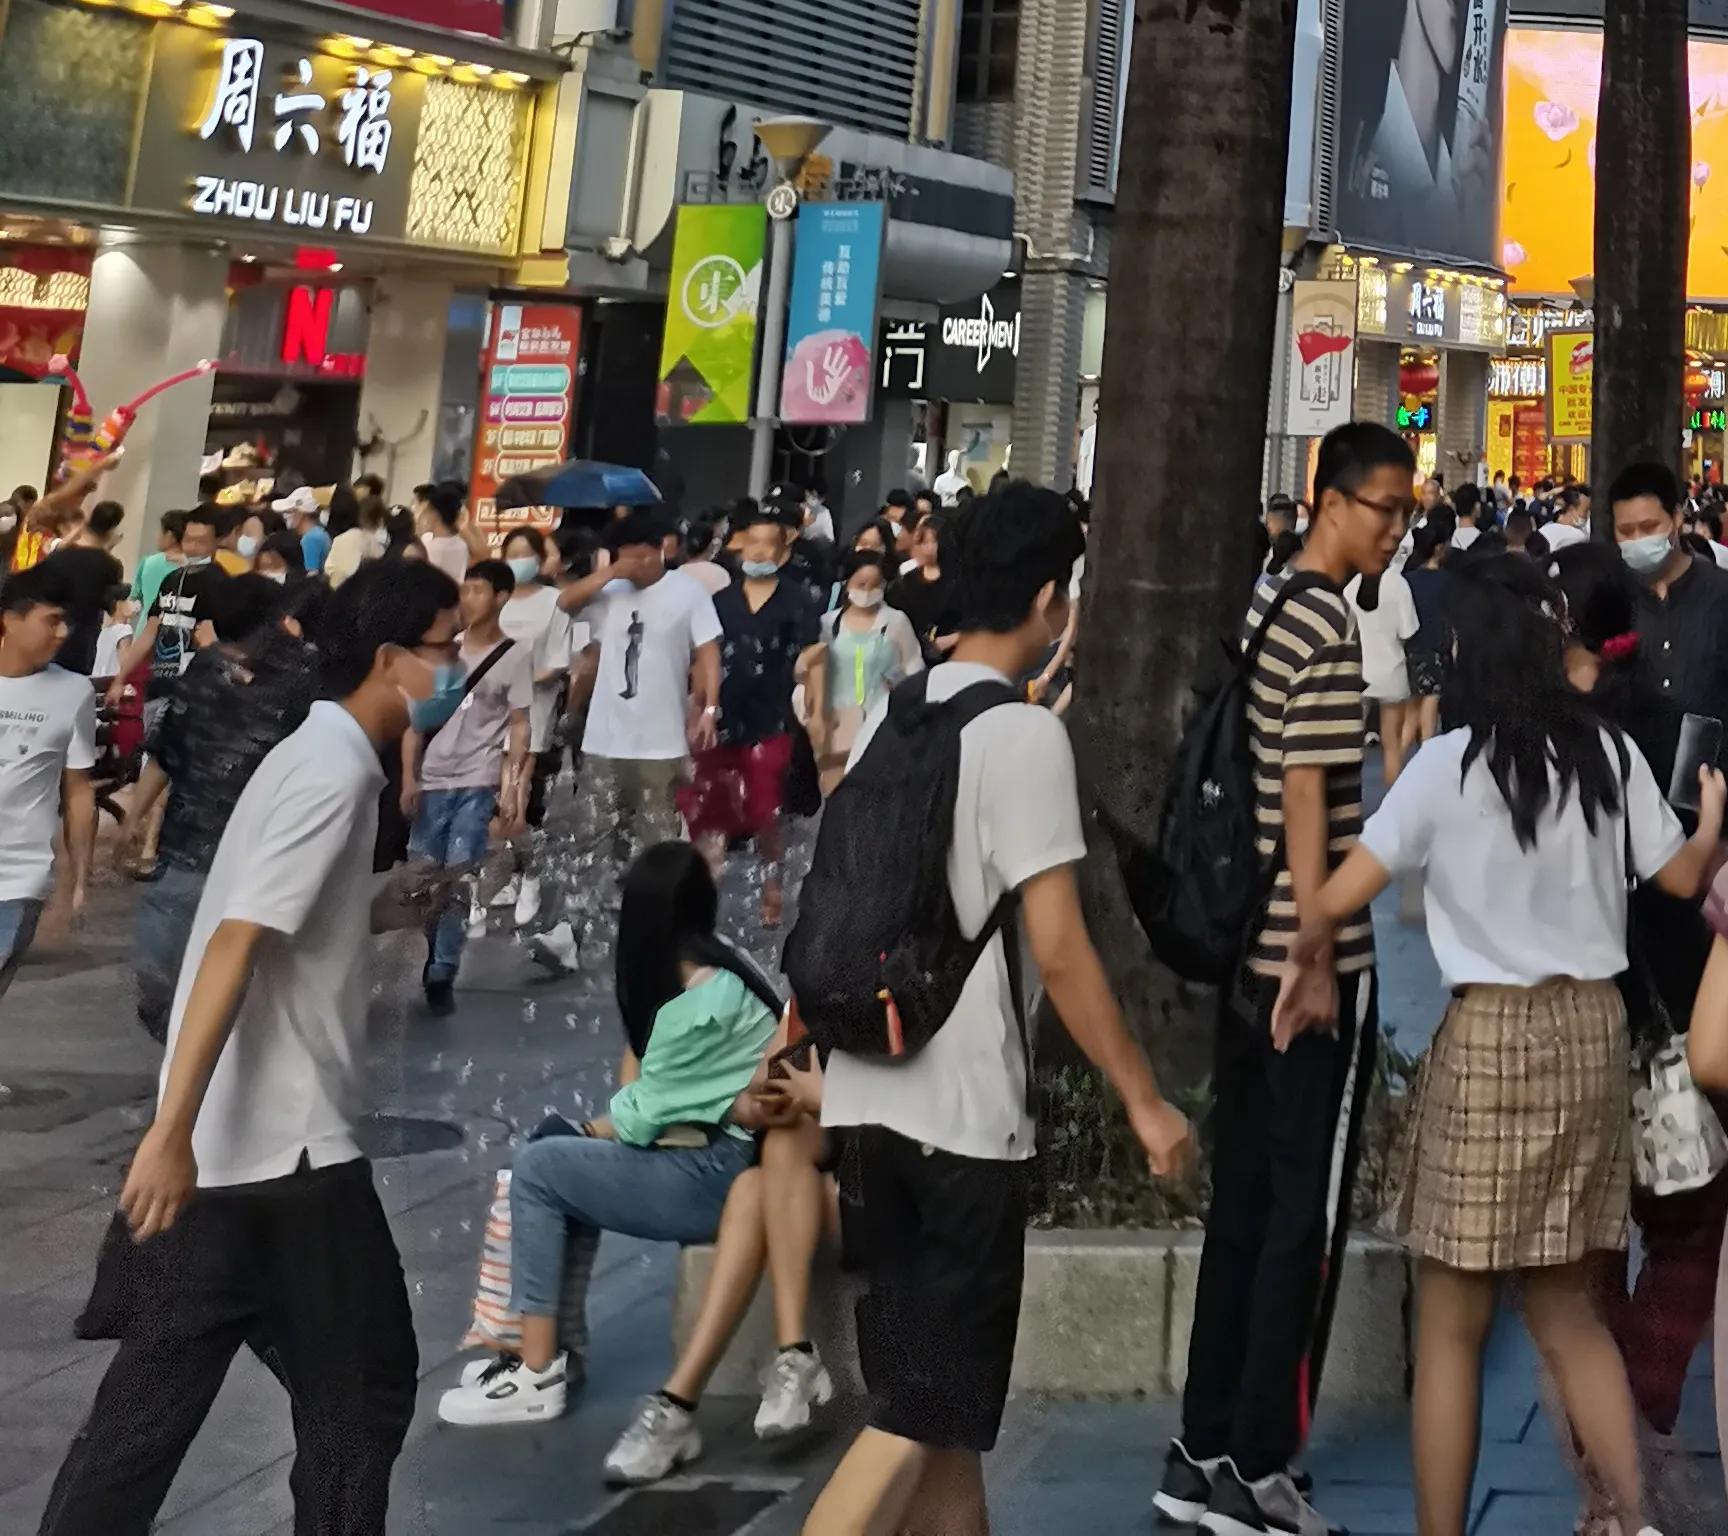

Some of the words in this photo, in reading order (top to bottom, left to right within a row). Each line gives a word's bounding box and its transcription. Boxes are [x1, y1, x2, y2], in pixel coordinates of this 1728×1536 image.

[199, 36, 395, 176] 周六福
[193, 174, 277, 220] ZHOU
[282, 188, 329, 228] LIU
[334, 196, 374, 234] FU
[943, 316, 988, 347] CAREER
